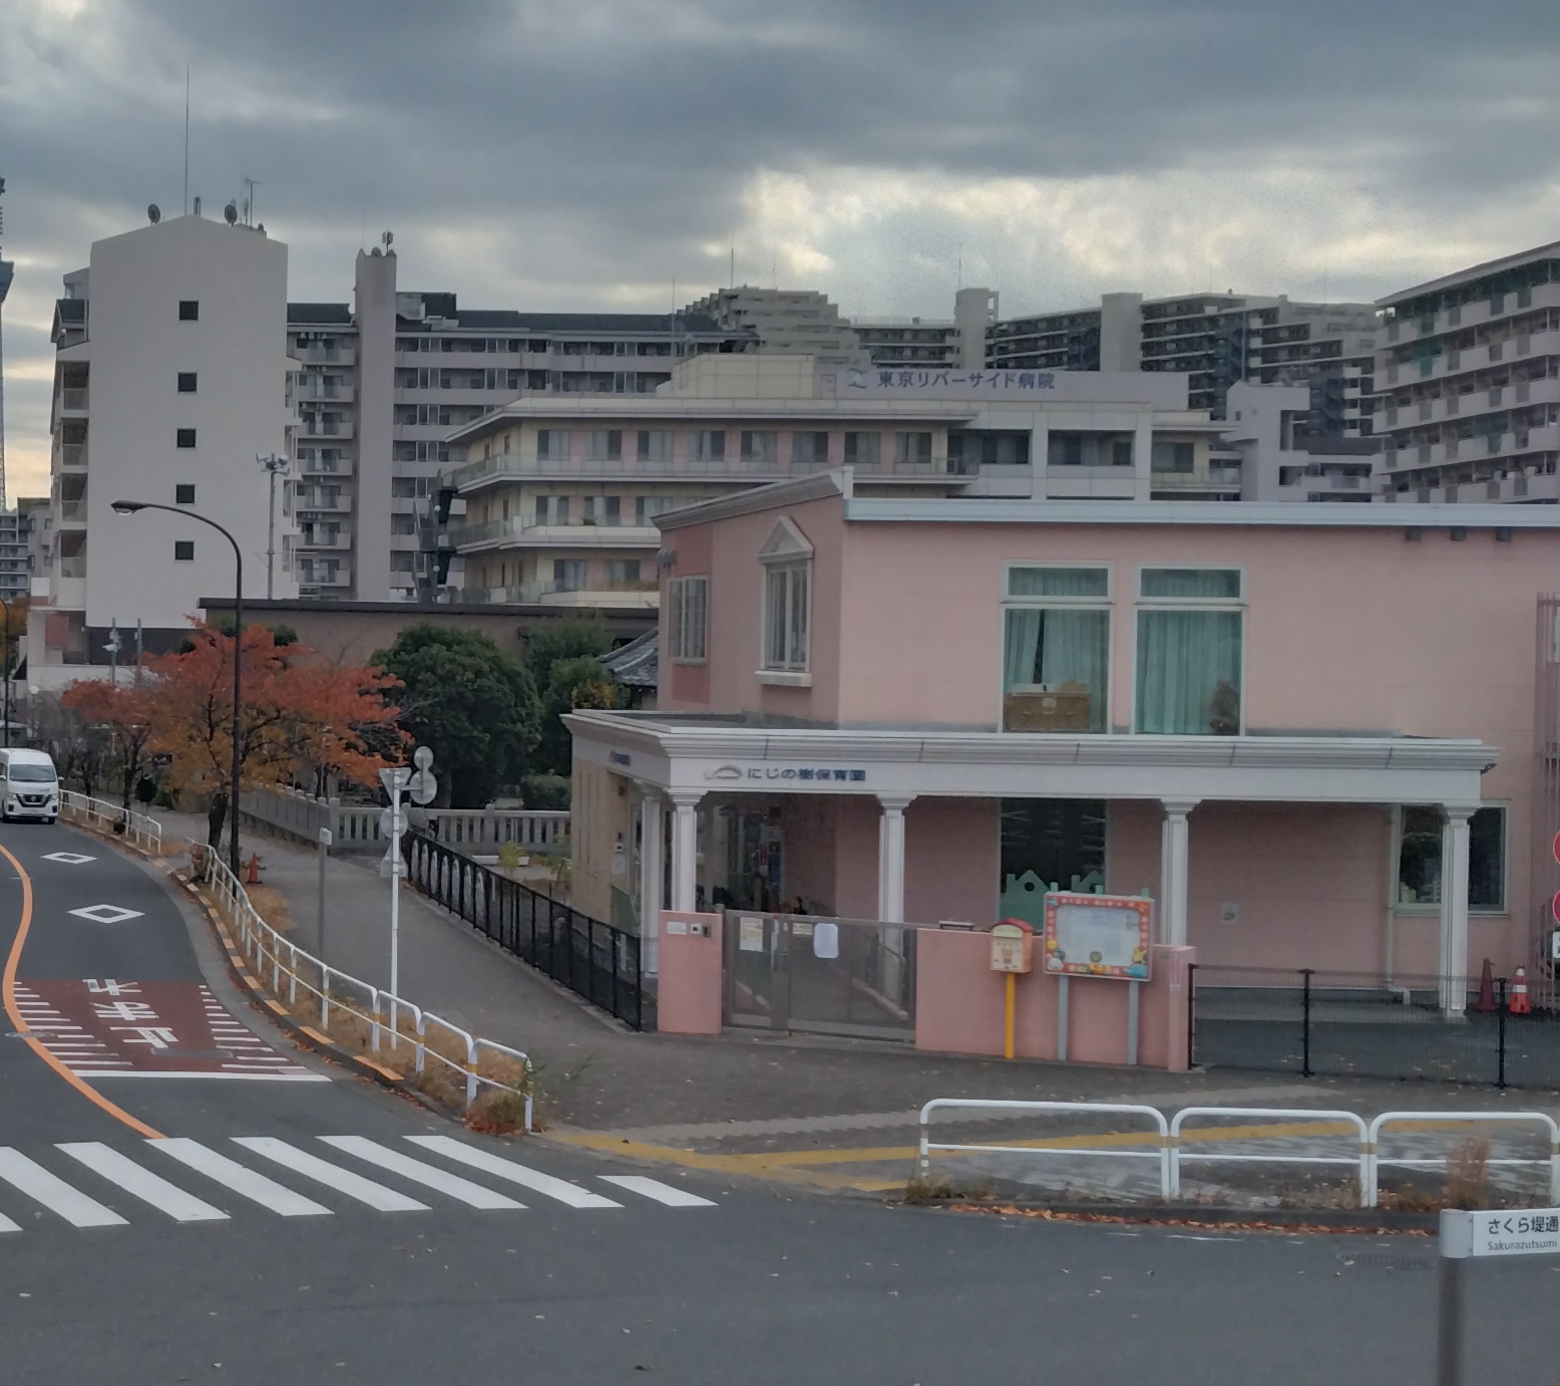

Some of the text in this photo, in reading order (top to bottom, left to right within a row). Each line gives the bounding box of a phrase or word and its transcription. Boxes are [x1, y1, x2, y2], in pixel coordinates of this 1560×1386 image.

[877, 371, 1055, 389] 東京リバーサイド病院
[1488, 1216, 1559, 1234] さくら堤通
[1487, 1238, 1558, 1251] Sakurazutsumi
